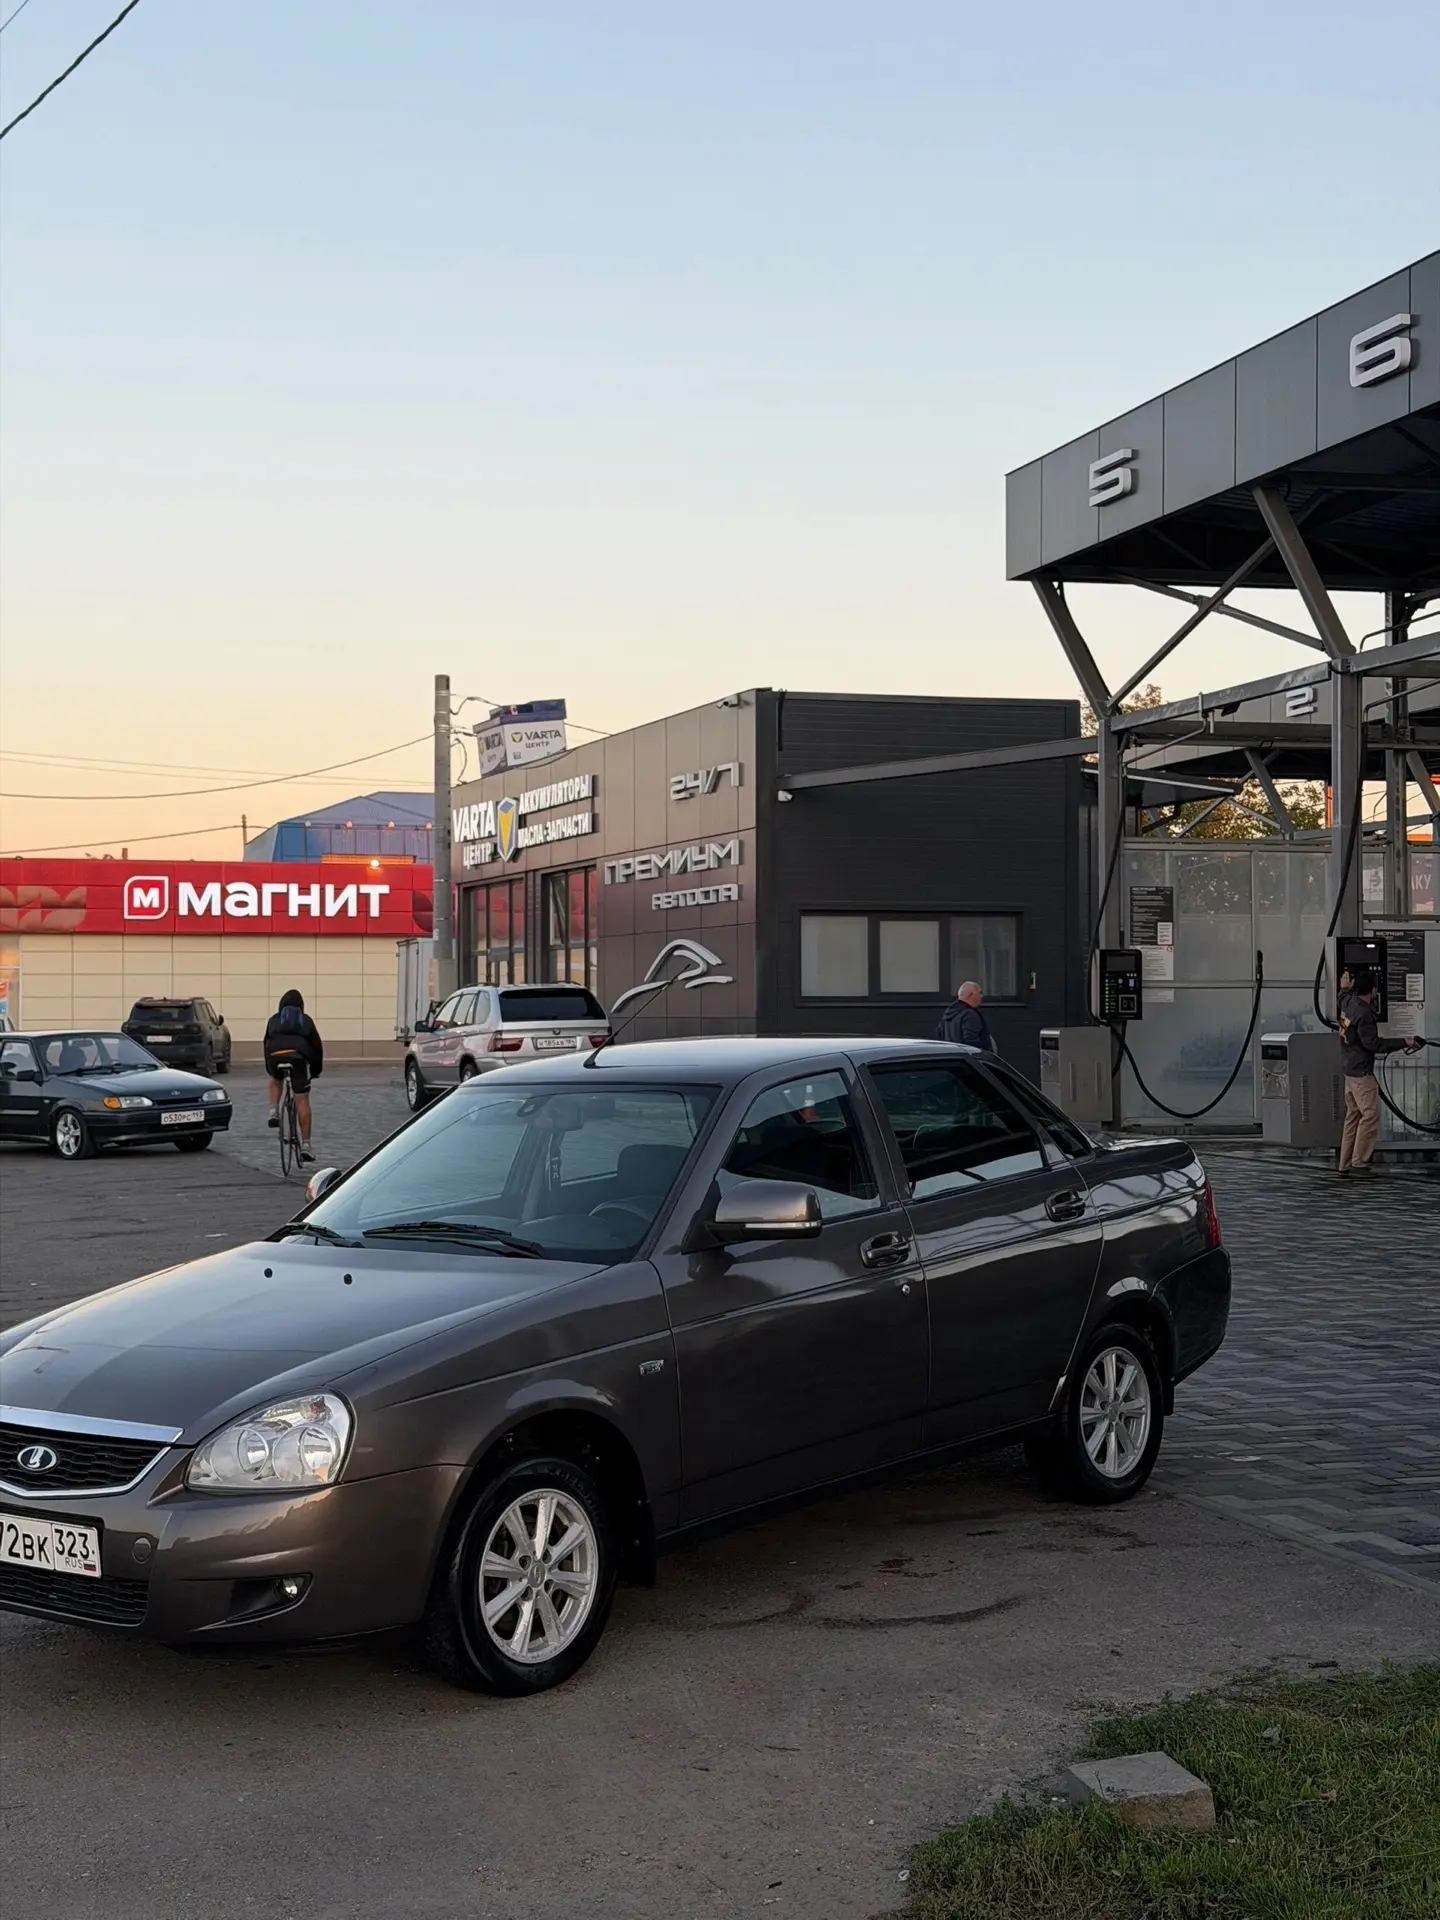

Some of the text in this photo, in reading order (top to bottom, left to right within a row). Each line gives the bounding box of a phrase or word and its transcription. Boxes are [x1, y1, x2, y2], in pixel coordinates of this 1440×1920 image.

[1350, 313, 1411, 388] 6
[1286, 687, 1314, 717] 2
[524, 729, 562, 741] VARTA
[525, 741, 550, 749] ЦЕНТР
[518, 775, 593, 815] АККУМУЛЯТОРЫ
[670, 762, 739, 800] 24/7
[452, 800, 496, 843] VARTA
[463, 842, 494, 870] ЦЕНТР
[604, 838, 739, 885] ПРЕМИУМ
[652, 884, 739, 910] АВТОСПА
[54, 1528, 91, 1560] 323
[65, 1556, 84, 1569] RUS
